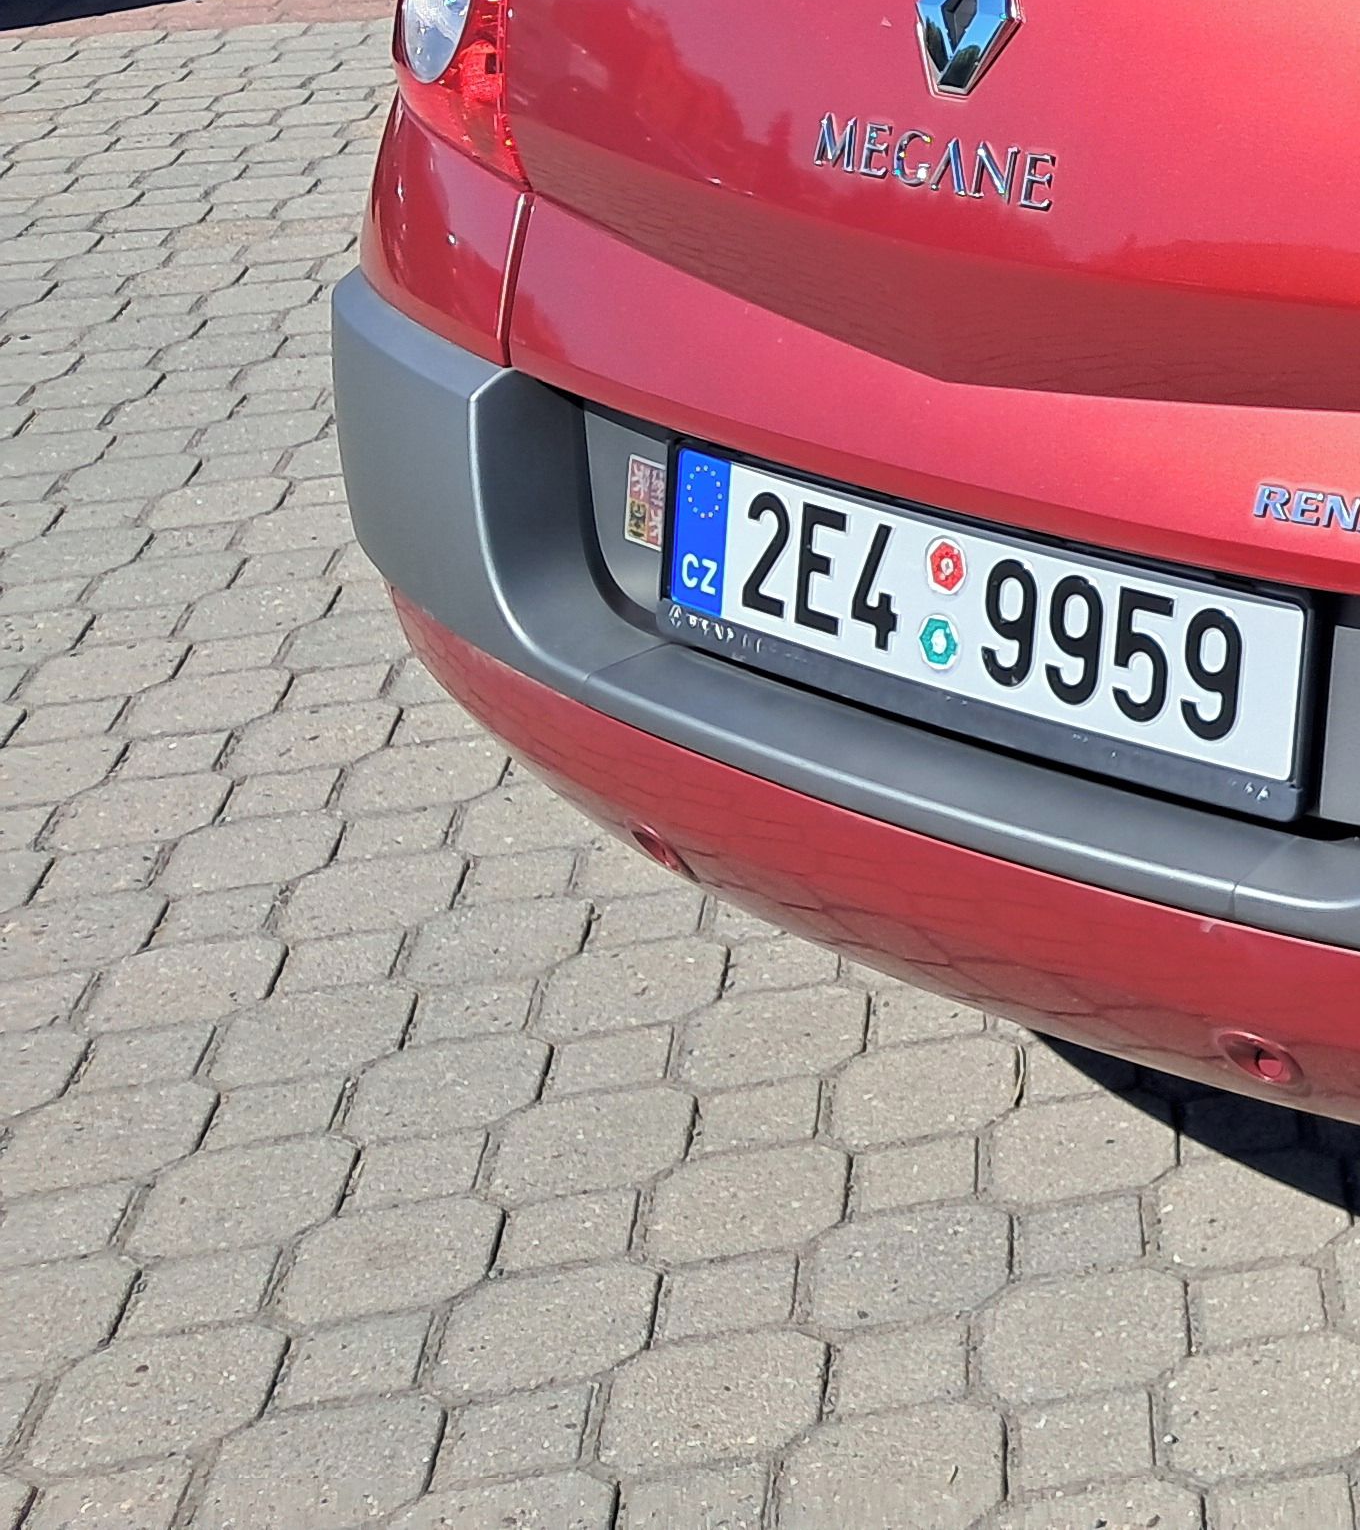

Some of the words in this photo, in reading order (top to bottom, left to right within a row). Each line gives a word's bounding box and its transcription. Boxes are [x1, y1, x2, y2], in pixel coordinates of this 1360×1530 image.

[813, 111, 1056, 213] MEGANE
[681, 553, 719, 596] CZ
[741, 491, 899, 652] 2E4
[980, 557, 1244, 742] 9959
